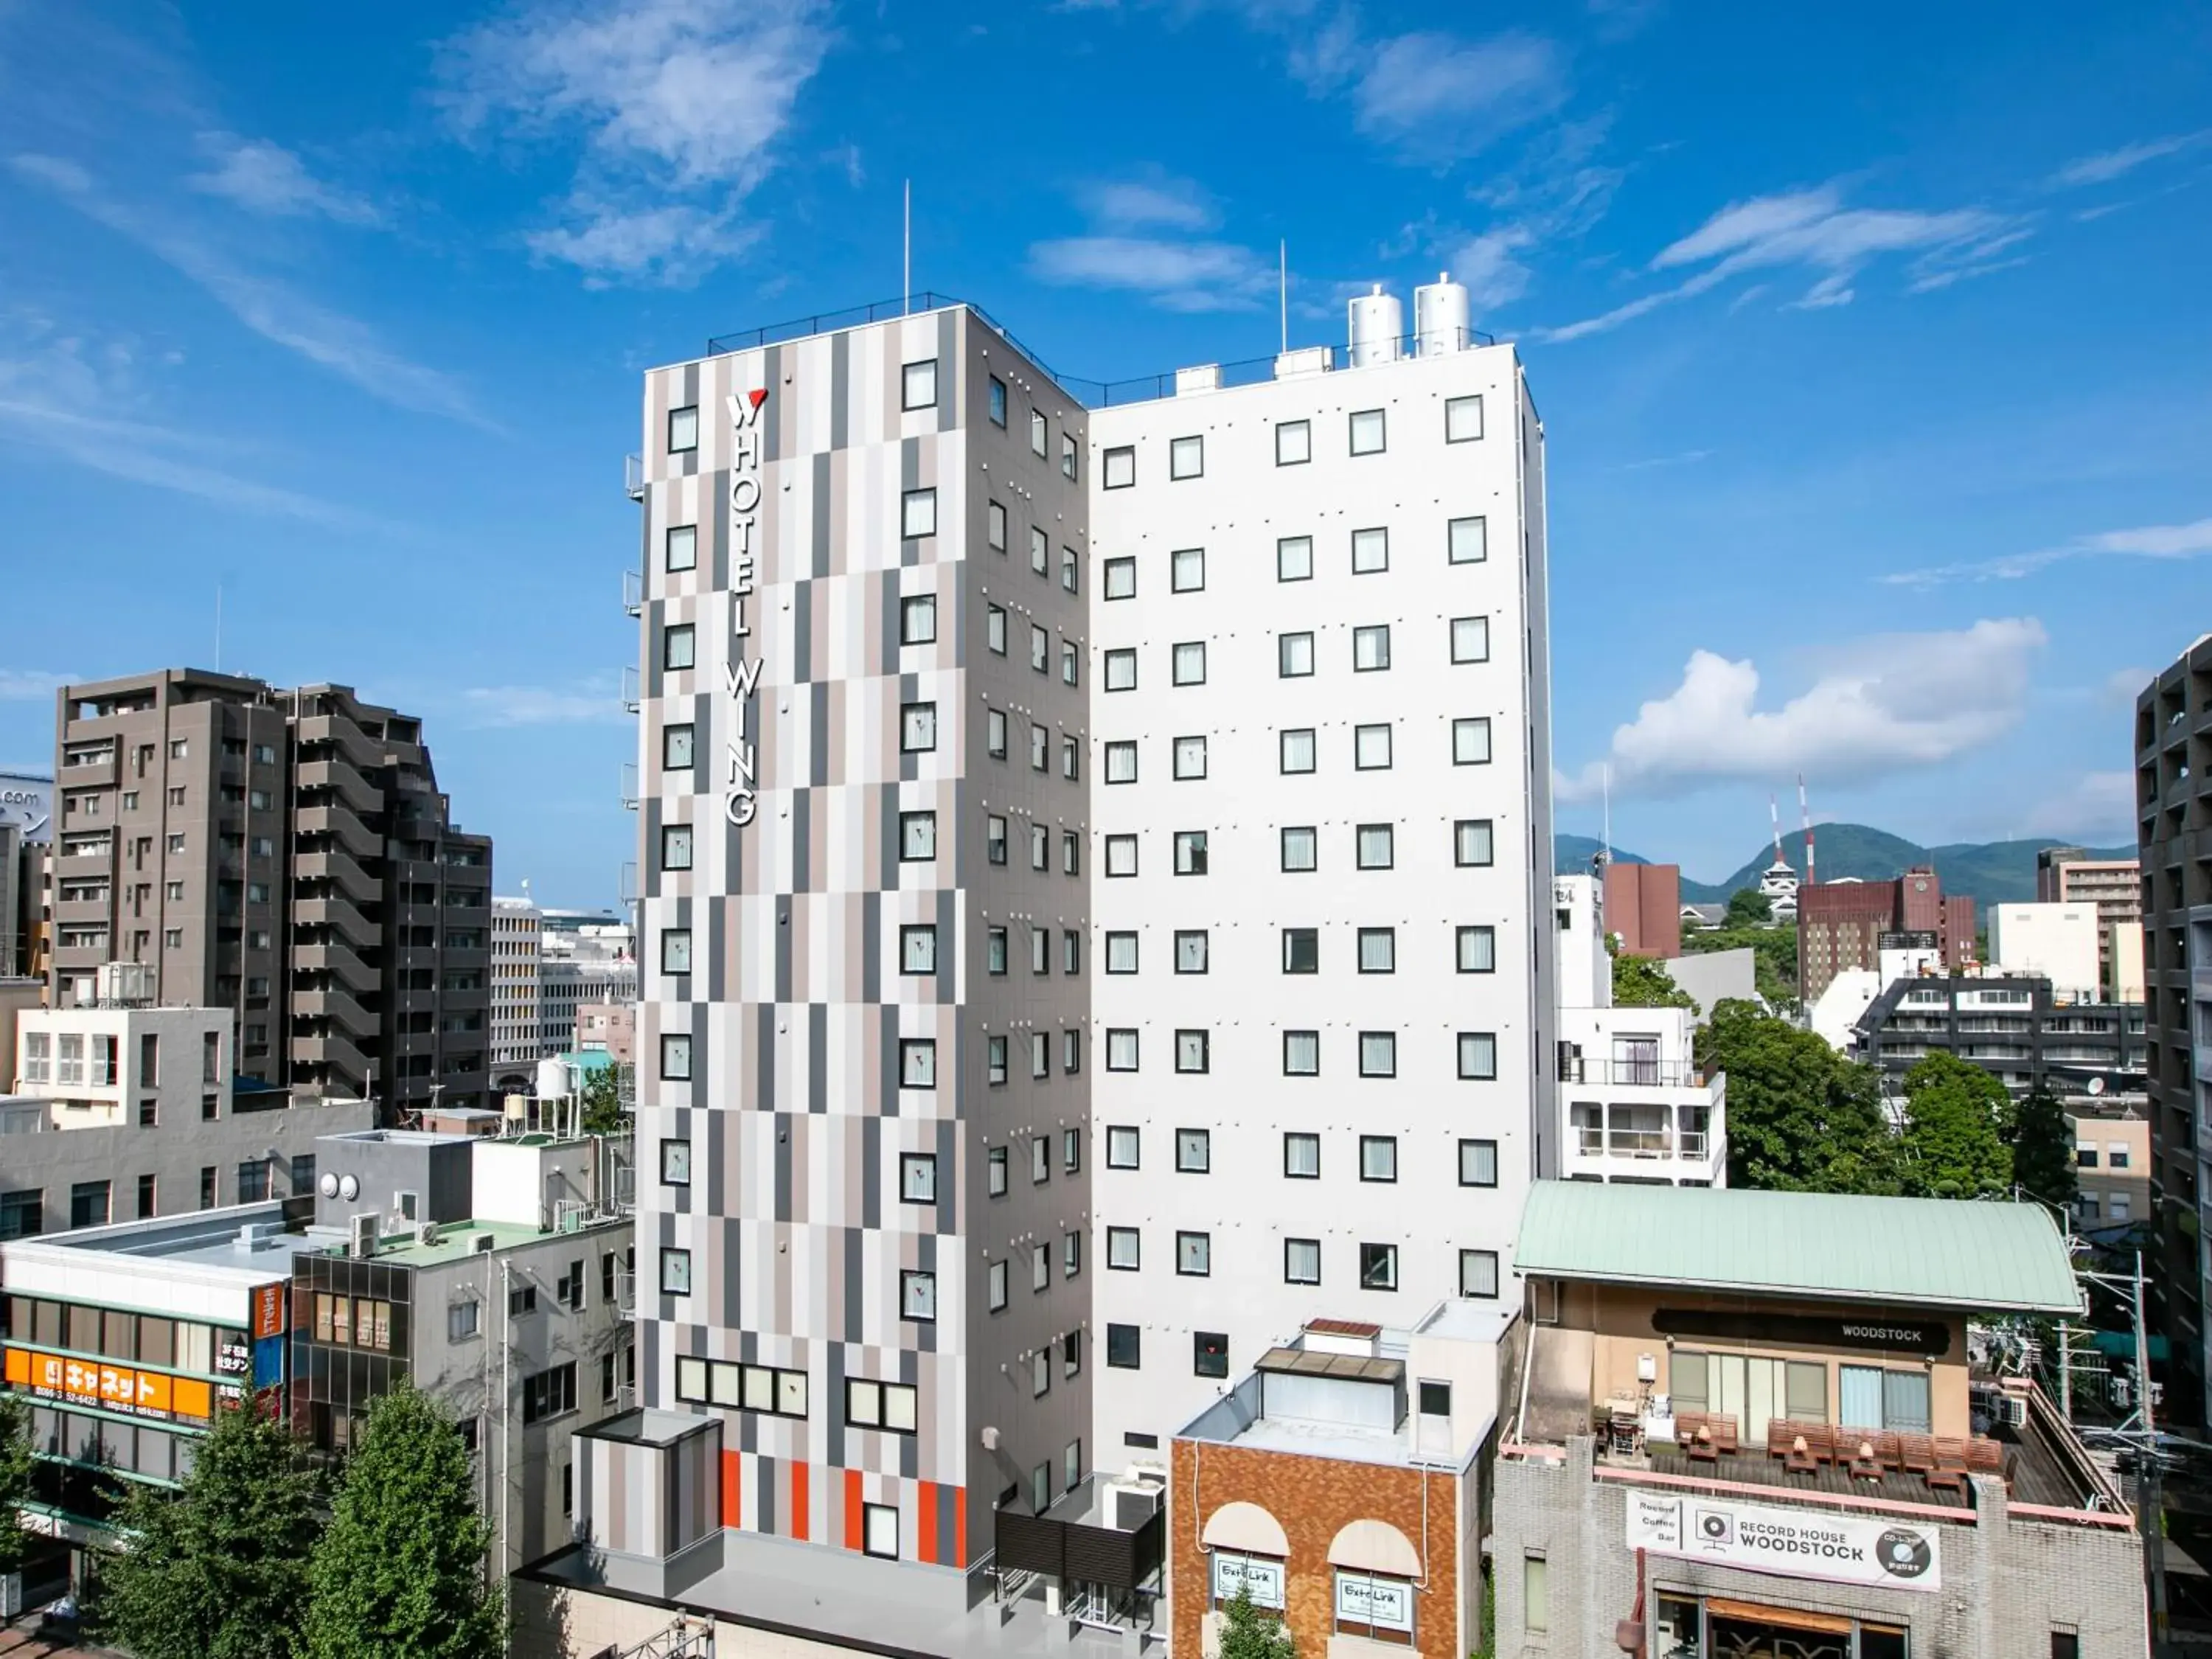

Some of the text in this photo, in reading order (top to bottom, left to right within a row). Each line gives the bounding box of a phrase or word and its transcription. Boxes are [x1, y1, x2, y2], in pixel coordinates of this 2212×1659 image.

[729, 432, 761, 636] HOTEL
[721, 658, 765, 828] WING
[1842, 1324, 1922, 1342] WOODSTOCK
[66, 1363, 154, 1402] キャネット
[1739, 1534, 1864, 1562] WOODSTOCK
[1740, 1521, 1846, 1543] RECORD HOUSE
